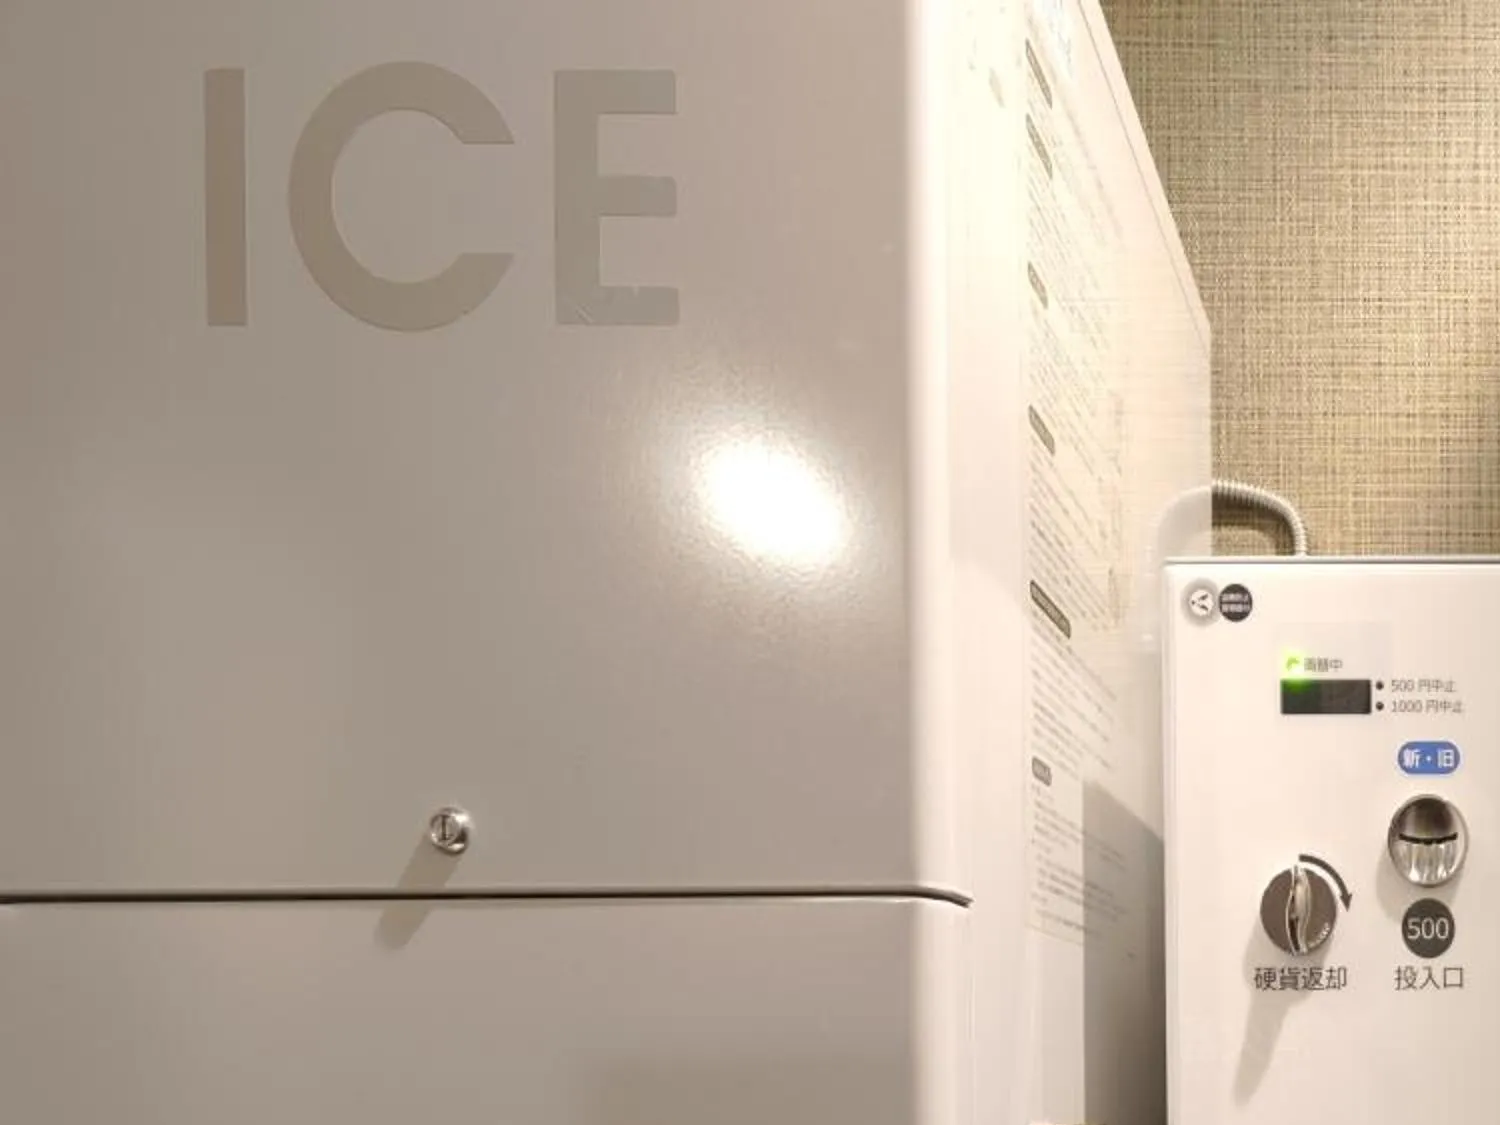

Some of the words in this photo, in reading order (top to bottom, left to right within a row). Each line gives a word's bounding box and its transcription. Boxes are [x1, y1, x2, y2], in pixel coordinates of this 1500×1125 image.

[205, 60, 680, 331] ICE
[1304, 657, 1343, 672] 両替中
[1391, 679, 1415, 693] 500
[1418, 679, 1456, 693] 円中止
[1391, 699, 1423, 713] 1000
[1426, 699, 1464, 713] 円中止
[1402, 748, 1454, 769] 新・旧
[1406, 917, 1449, 940] 500
[1253, 966, 1348, 990] 硬貨返却
[1395, 965, 1464, 990] 投入口
